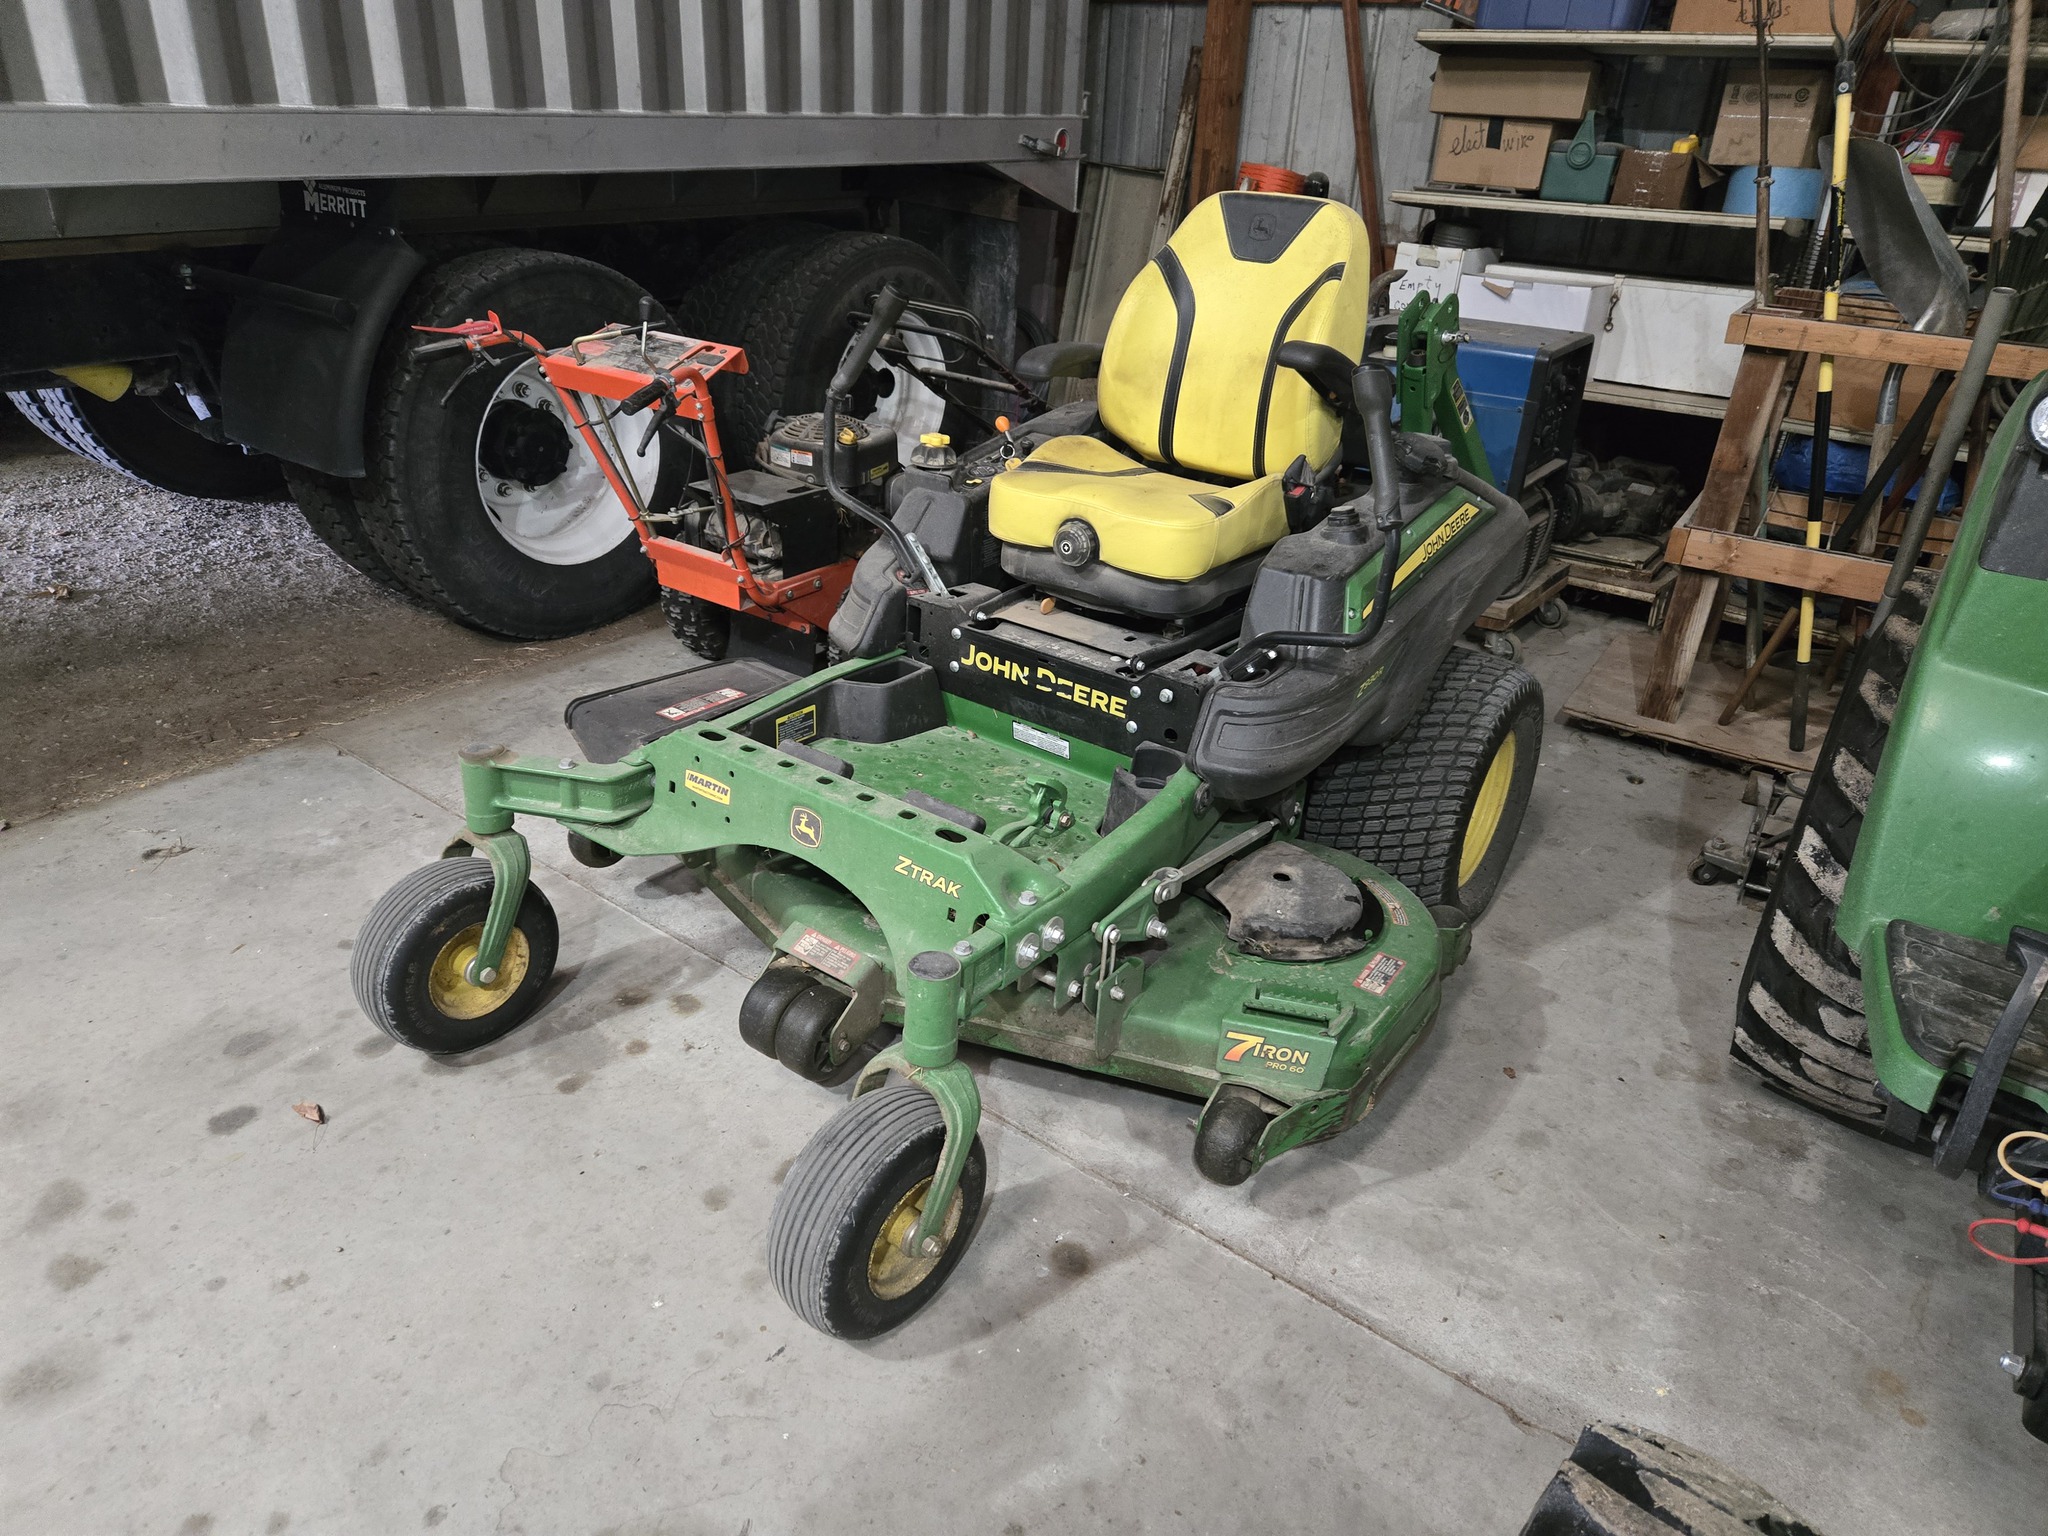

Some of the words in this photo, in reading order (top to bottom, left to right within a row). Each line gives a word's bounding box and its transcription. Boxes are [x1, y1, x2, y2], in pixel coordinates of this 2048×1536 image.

[1450, 121, 1485, 156] elect
[303, 190, 367, 218] MERRITT
[1399, 275, 1441, 300] Empty
[1422, 530, 1444, 562] JOHN
[1443, 508, 1471, 540] DEERE
[960, 644, 1030, 686] JOHN
[1035, 666, 1128, 719] DEERE
[688, 773, 729, 796] MARTIN
[893, 854, 964, 899] ZTRAK
[1265, 1061, 1287, 1071] PRO
[1289, 1065, 1305, 1074] 60
